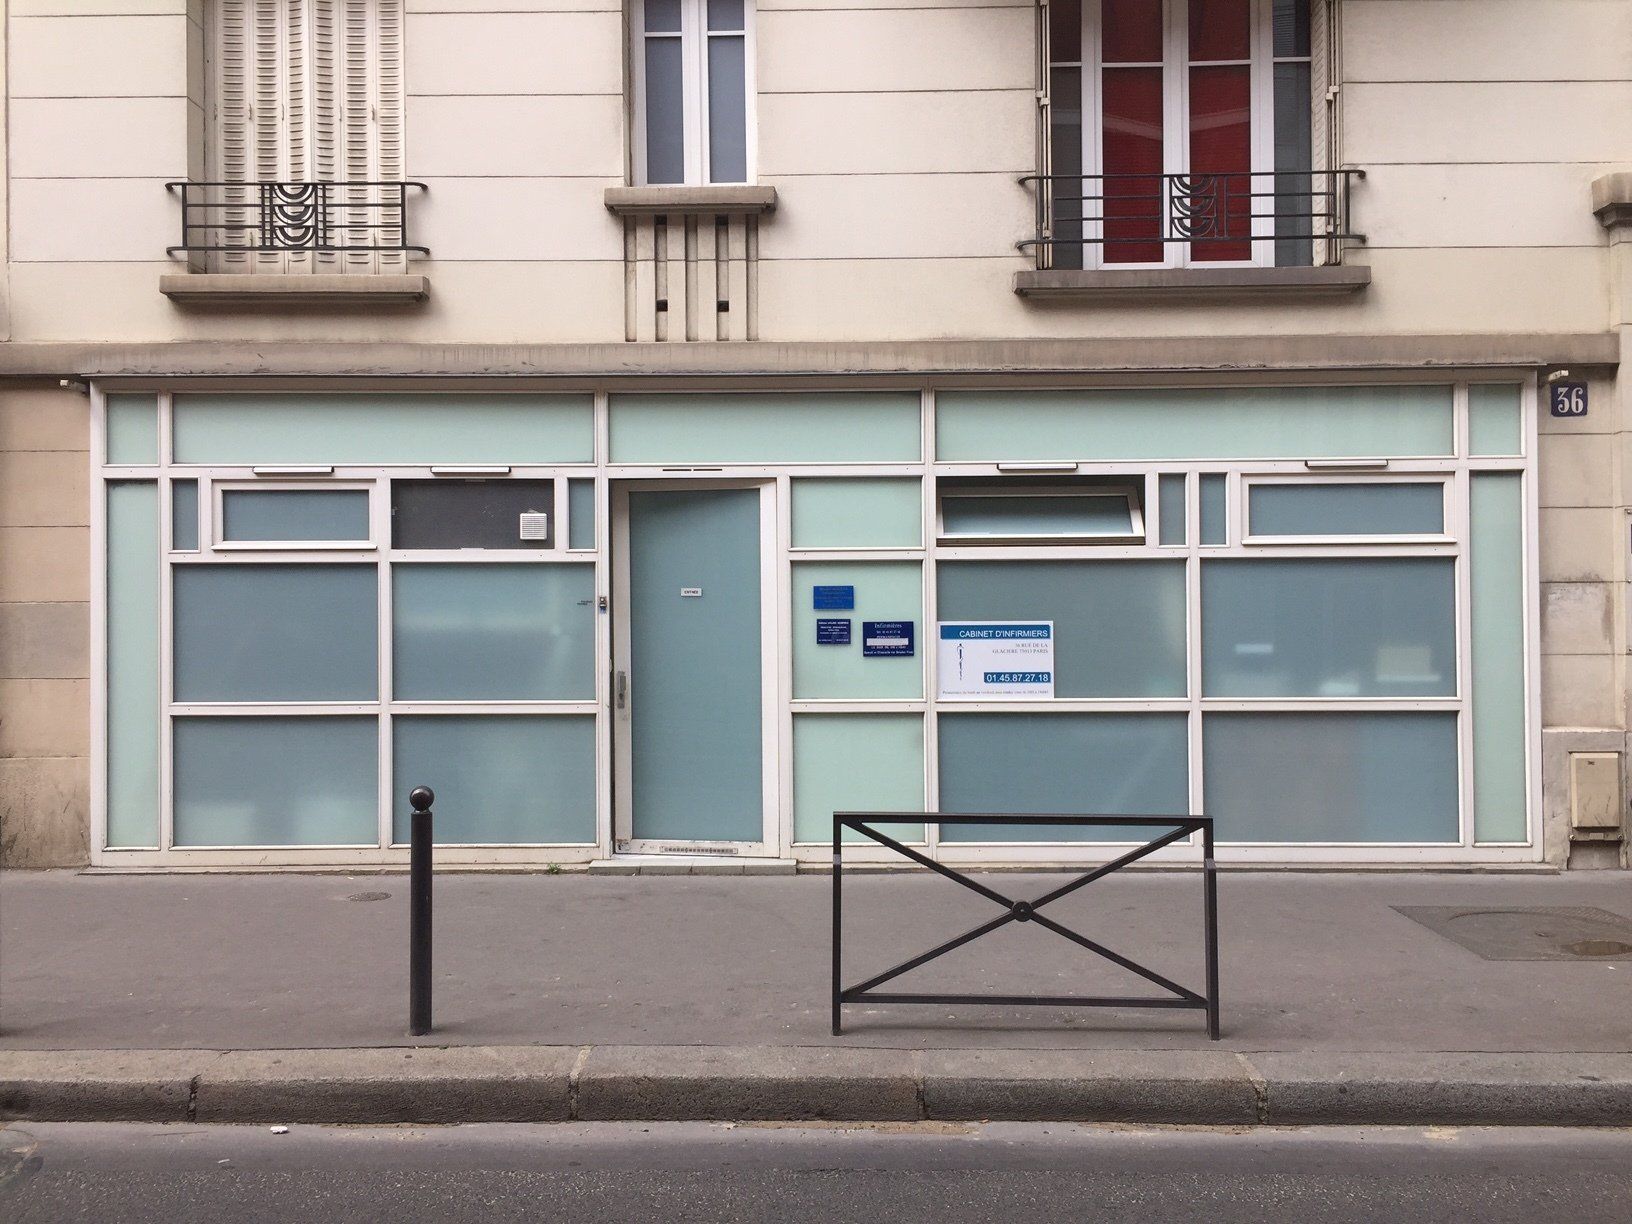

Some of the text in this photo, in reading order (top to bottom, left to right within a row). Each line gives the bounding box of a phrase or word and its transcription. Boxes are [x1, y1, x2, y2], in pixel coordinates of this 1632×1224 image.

[1557, 387, 1584, 413] 36
[959, 630, 1048, 638] CABINET D'INFIRMIERS
[986, 674, 1048, 683] 01.45.87.27.18
